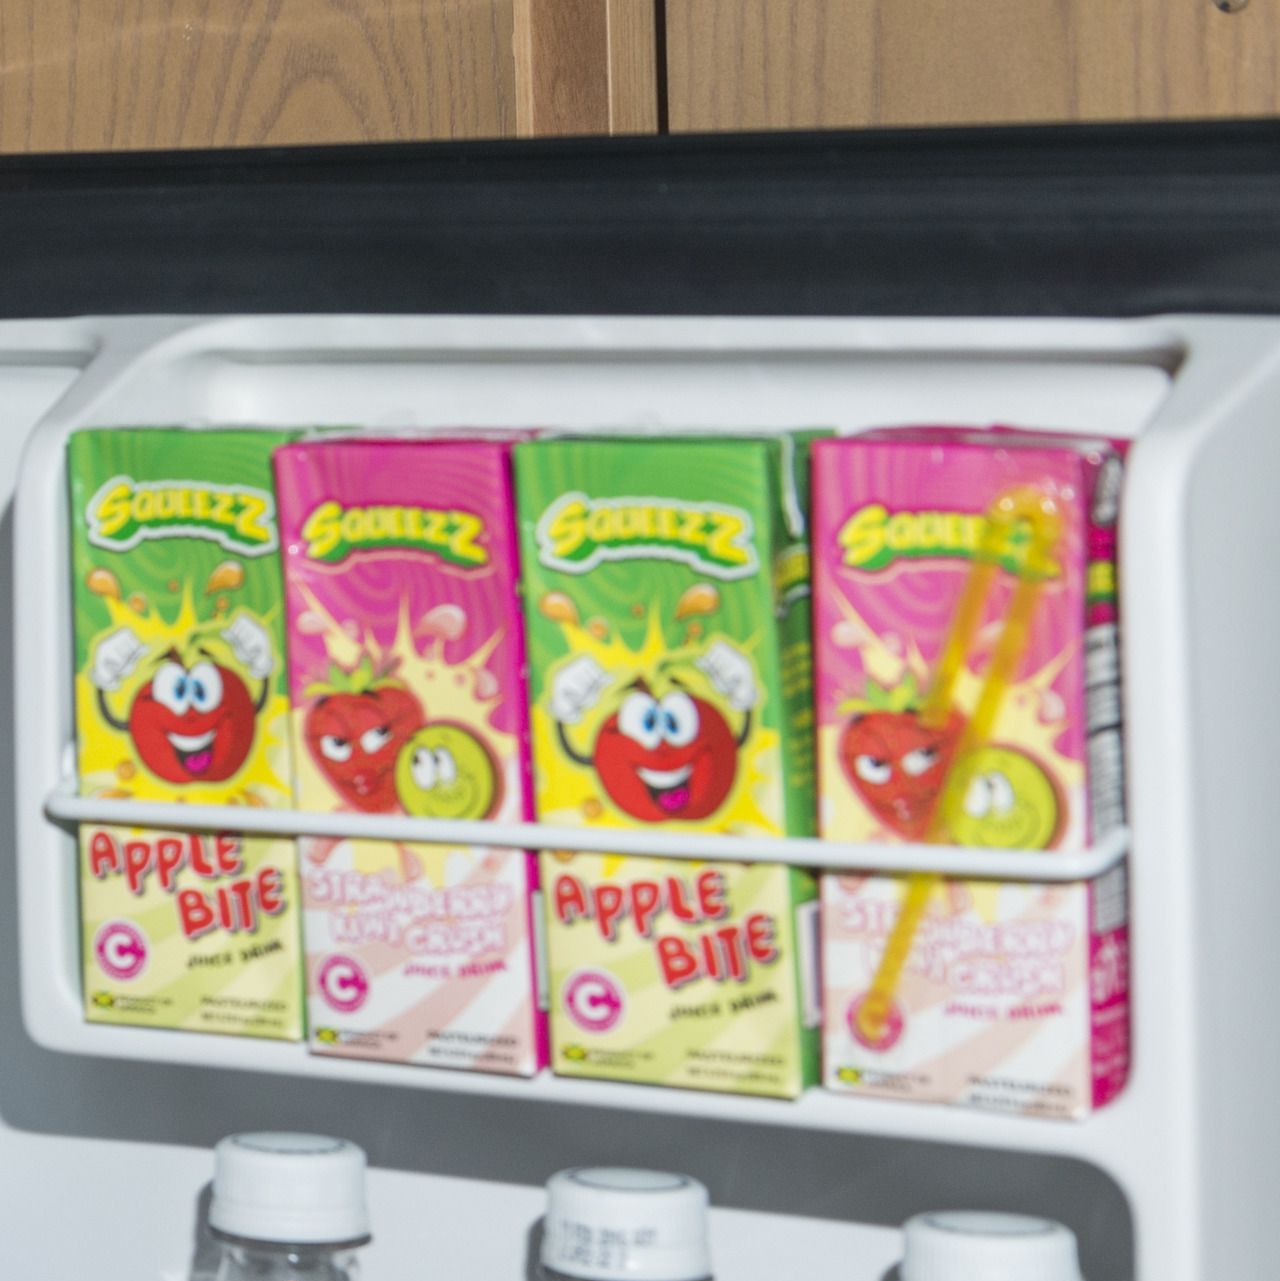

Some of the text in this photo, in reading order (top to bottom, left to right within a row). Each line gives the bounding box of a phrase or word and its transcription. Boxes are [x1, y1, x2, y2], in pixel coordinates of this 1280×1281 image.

[90, 830, 242, 892] APPLE
[177, 867, 282, 938] BITE
[555, 870, 724, 940] APPLE
[656, 912, 776, 987] BITE
